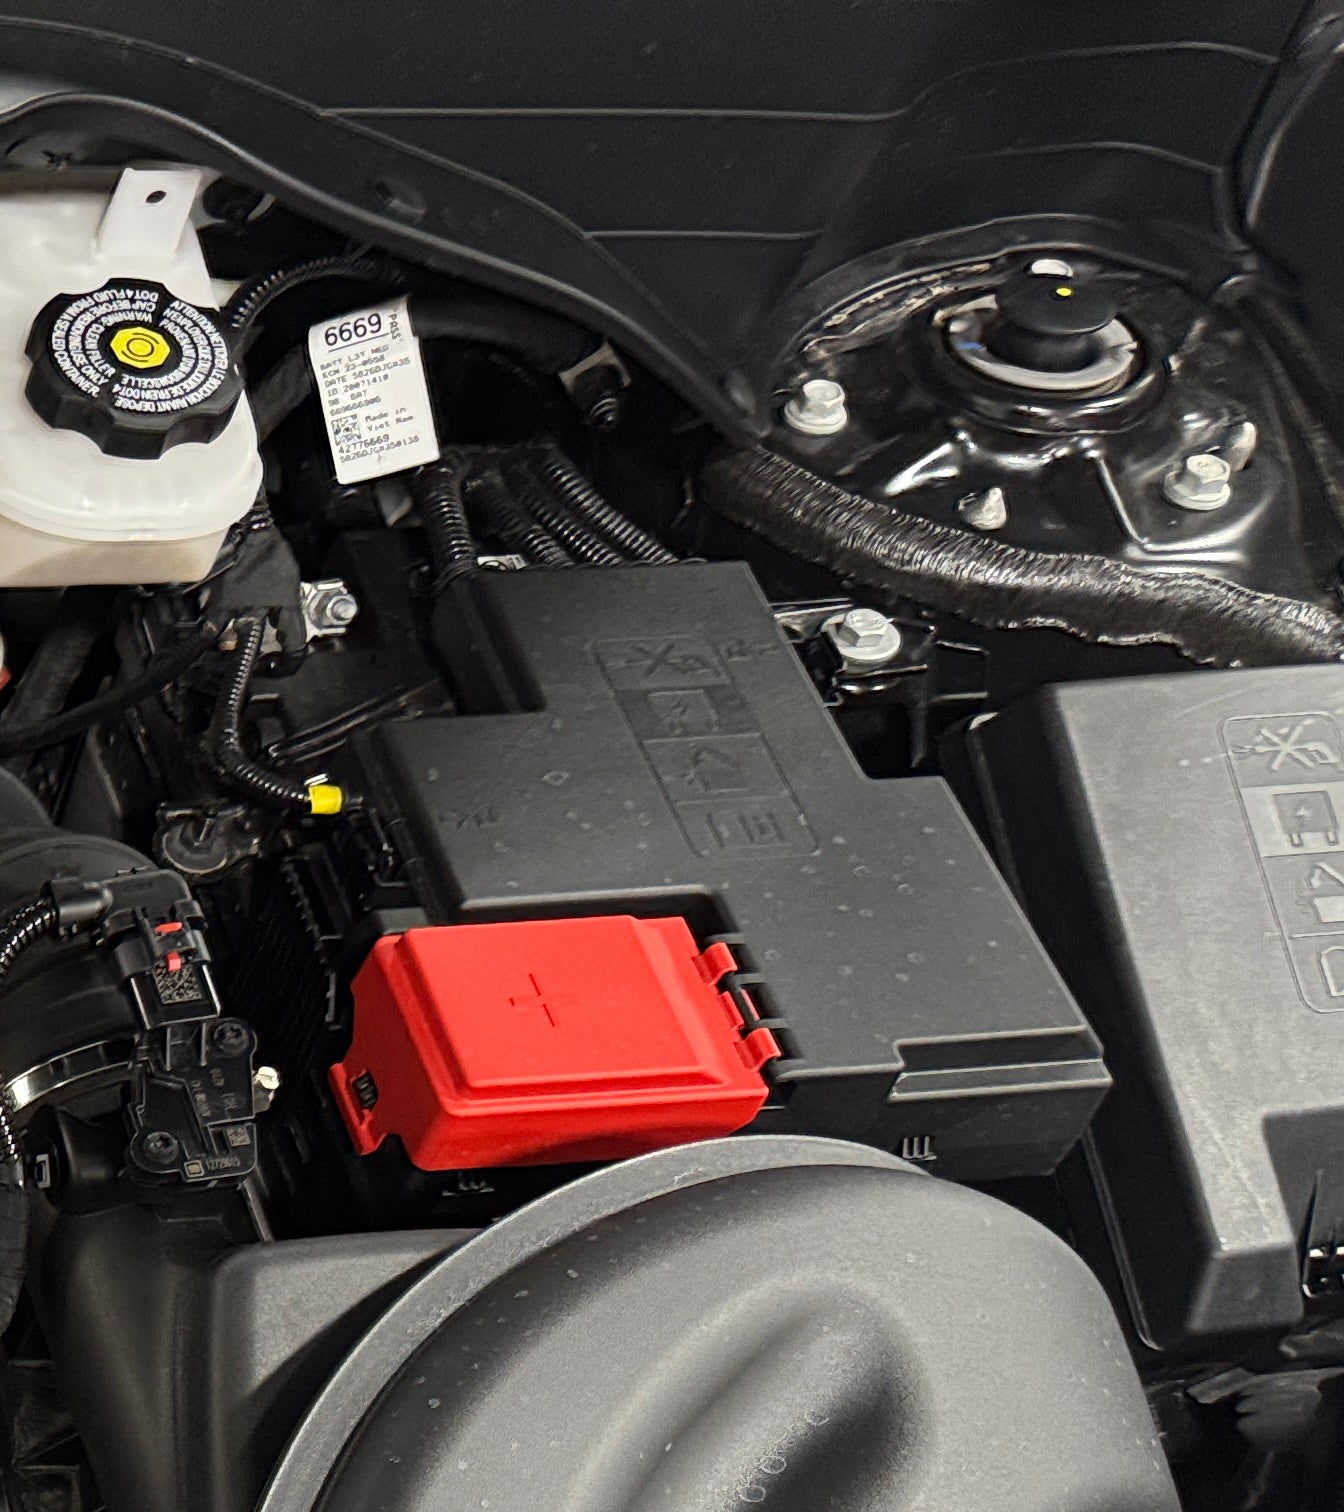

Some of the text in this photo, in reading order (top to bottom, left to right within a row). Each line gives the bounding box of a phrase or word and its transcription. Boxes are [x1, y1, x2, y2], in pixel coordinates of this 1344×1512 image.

[92, 289, 125, 303] FLUID
[125, 289, 133, 298] 4
[133, 290, 159, 302] DOT
[66, 296, 96, 316] FROM
[89, 300, 132, 318] BEFORE
[132, 302, 157, 312] CAP
[52, 318, 70, 350] SEALED
[84, 322, 105, 351] CLEAN
[325, 313, 381, 346] 6669
[70, 349, 88, 368] USE
[87, 351, 116, 379] FILLER
[81, 365, 109, 387] ONLY
[325, 375, 347, 387] DATE
[112, 385, 120, 394] 4
[119, 387, 142, 399] DOT
[365, 407, 406, 422] Made in
